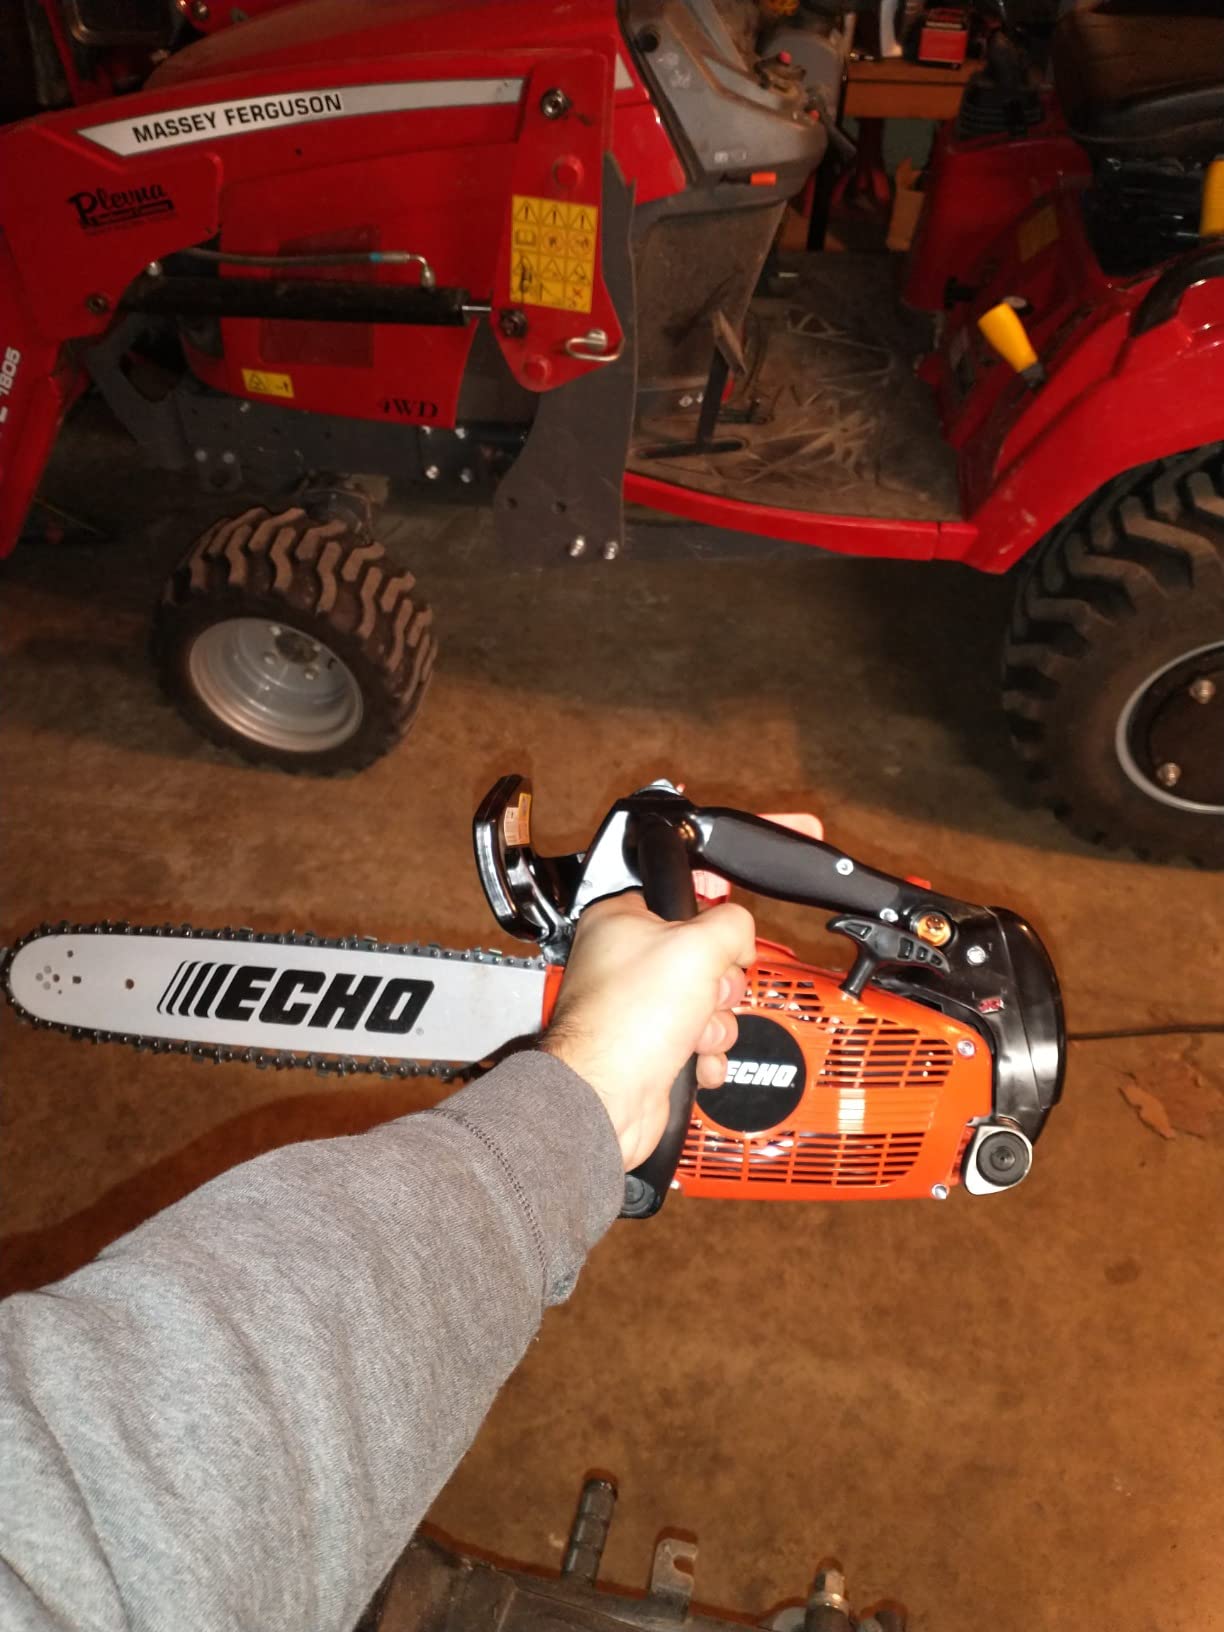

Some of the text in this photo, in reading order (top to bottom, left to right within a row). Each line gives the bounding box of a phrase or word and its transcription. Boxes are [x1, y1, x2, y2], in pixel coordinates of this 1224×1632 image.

[132, 93, 342, 144] MASSEY FERGUSON
[215, 965, 435, 1035] ECHO
[724, 1060, 798, 1088] ECHO
